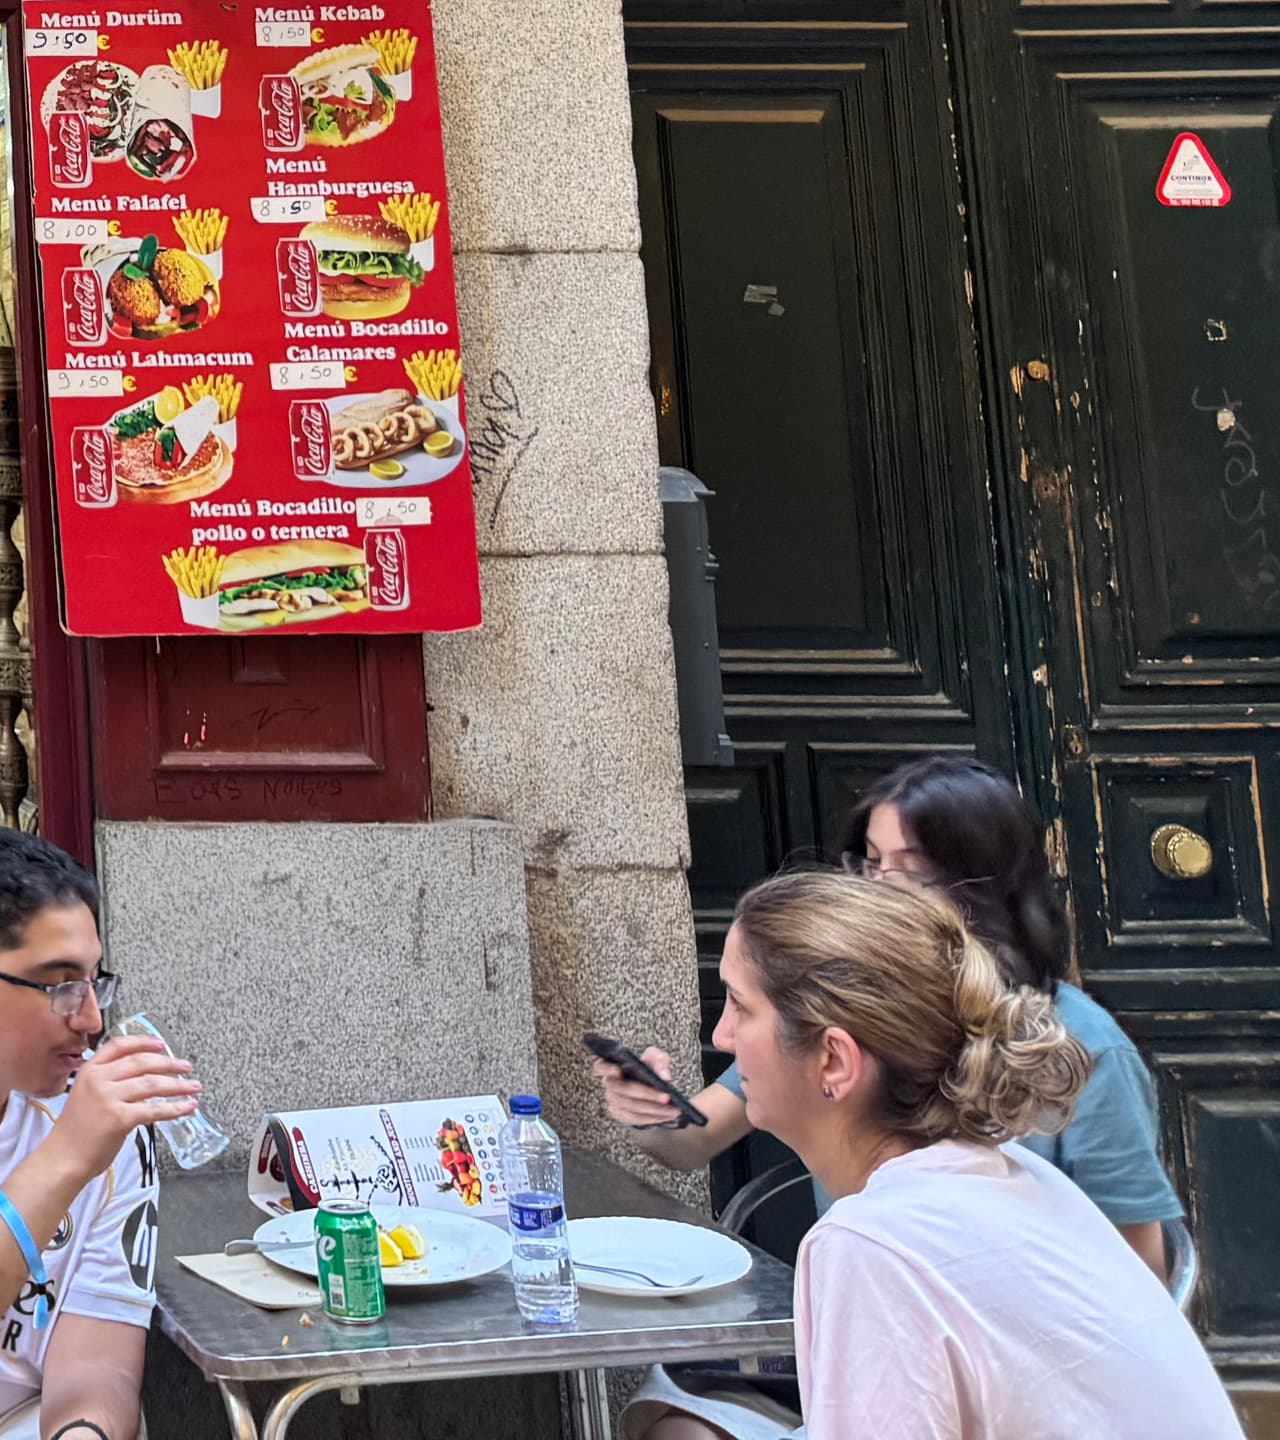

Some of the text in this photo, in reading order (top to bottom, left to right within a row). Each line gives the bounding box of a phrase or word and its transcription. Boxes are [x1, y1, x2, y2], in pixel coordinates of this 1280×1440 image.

[41, 8, 182, 28] Menú Durüm
[255, 4, 385, 23] Menú Kebab
[266, 156, 326, 174] Menú
[268, 179, 416, 200] Hamburguesa
[51, 193, 188, 213] Menú Falafel
[284, 318, 448, 339] Menú Bocadillo
[65, 349, 254, 369] Menú Lahmacum
[286, 344, 396, 362] Calamares
[190, 497, 356, 518] Menú Bocadillo
[193, 523, 349, 545] pollo o ternera
